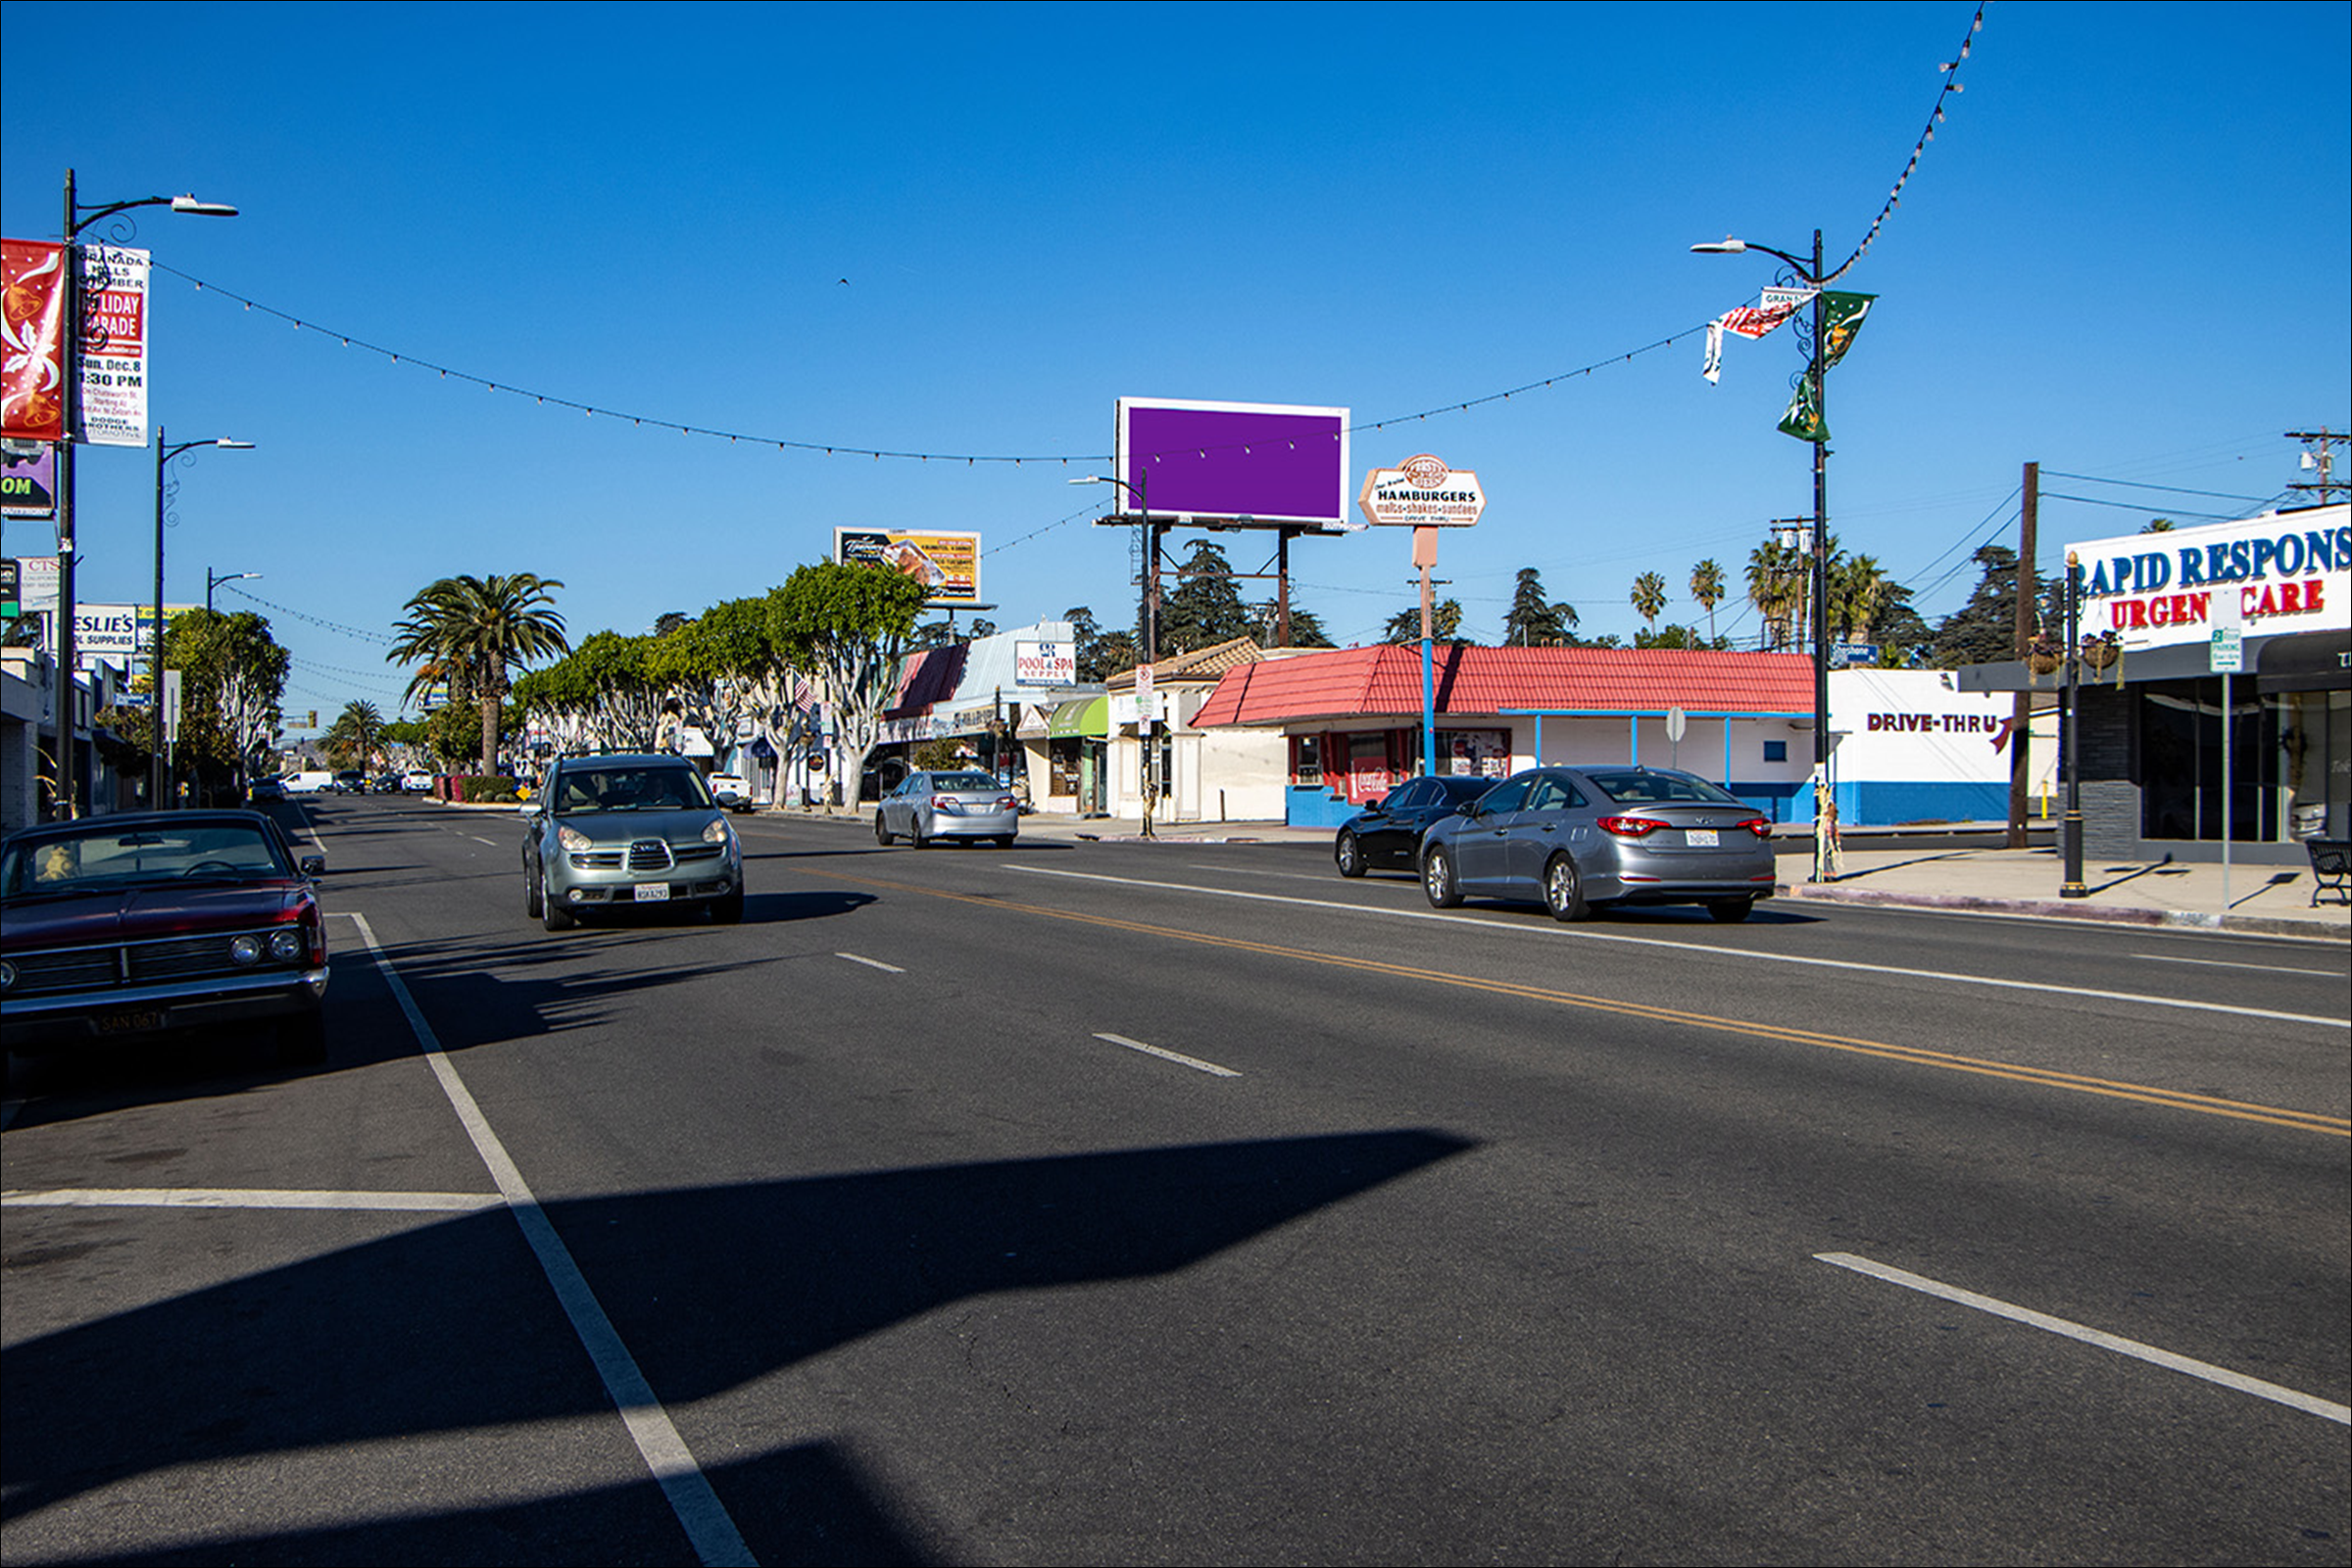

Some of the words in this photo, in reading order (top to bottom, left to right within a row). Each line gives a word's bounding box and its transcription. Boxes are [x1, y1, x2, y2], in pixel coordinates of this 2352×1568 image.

[77, 356, 105, 370] Sun.
[106, 359, 132, 372] Dec.
[133, 361, 141, 372] 8
[117, 375, 142, 387] PM
[1378, 490, 1476, 502] HAMBURGERS
[2111, 591, 2212, 630] URGEN
[2240, 579, 2325, 619] CARE
[75, 613, 133, 632] ESLIE'S
[87, 635, 133, 645] SUPPLIES
[2215, 631, 2221, 640] 2
[1018, 657, 1045, 669] POOL
[1054, 658, 1074, 670] SPA
[1867, 712, 1997, 733] DRIVE-THRU
